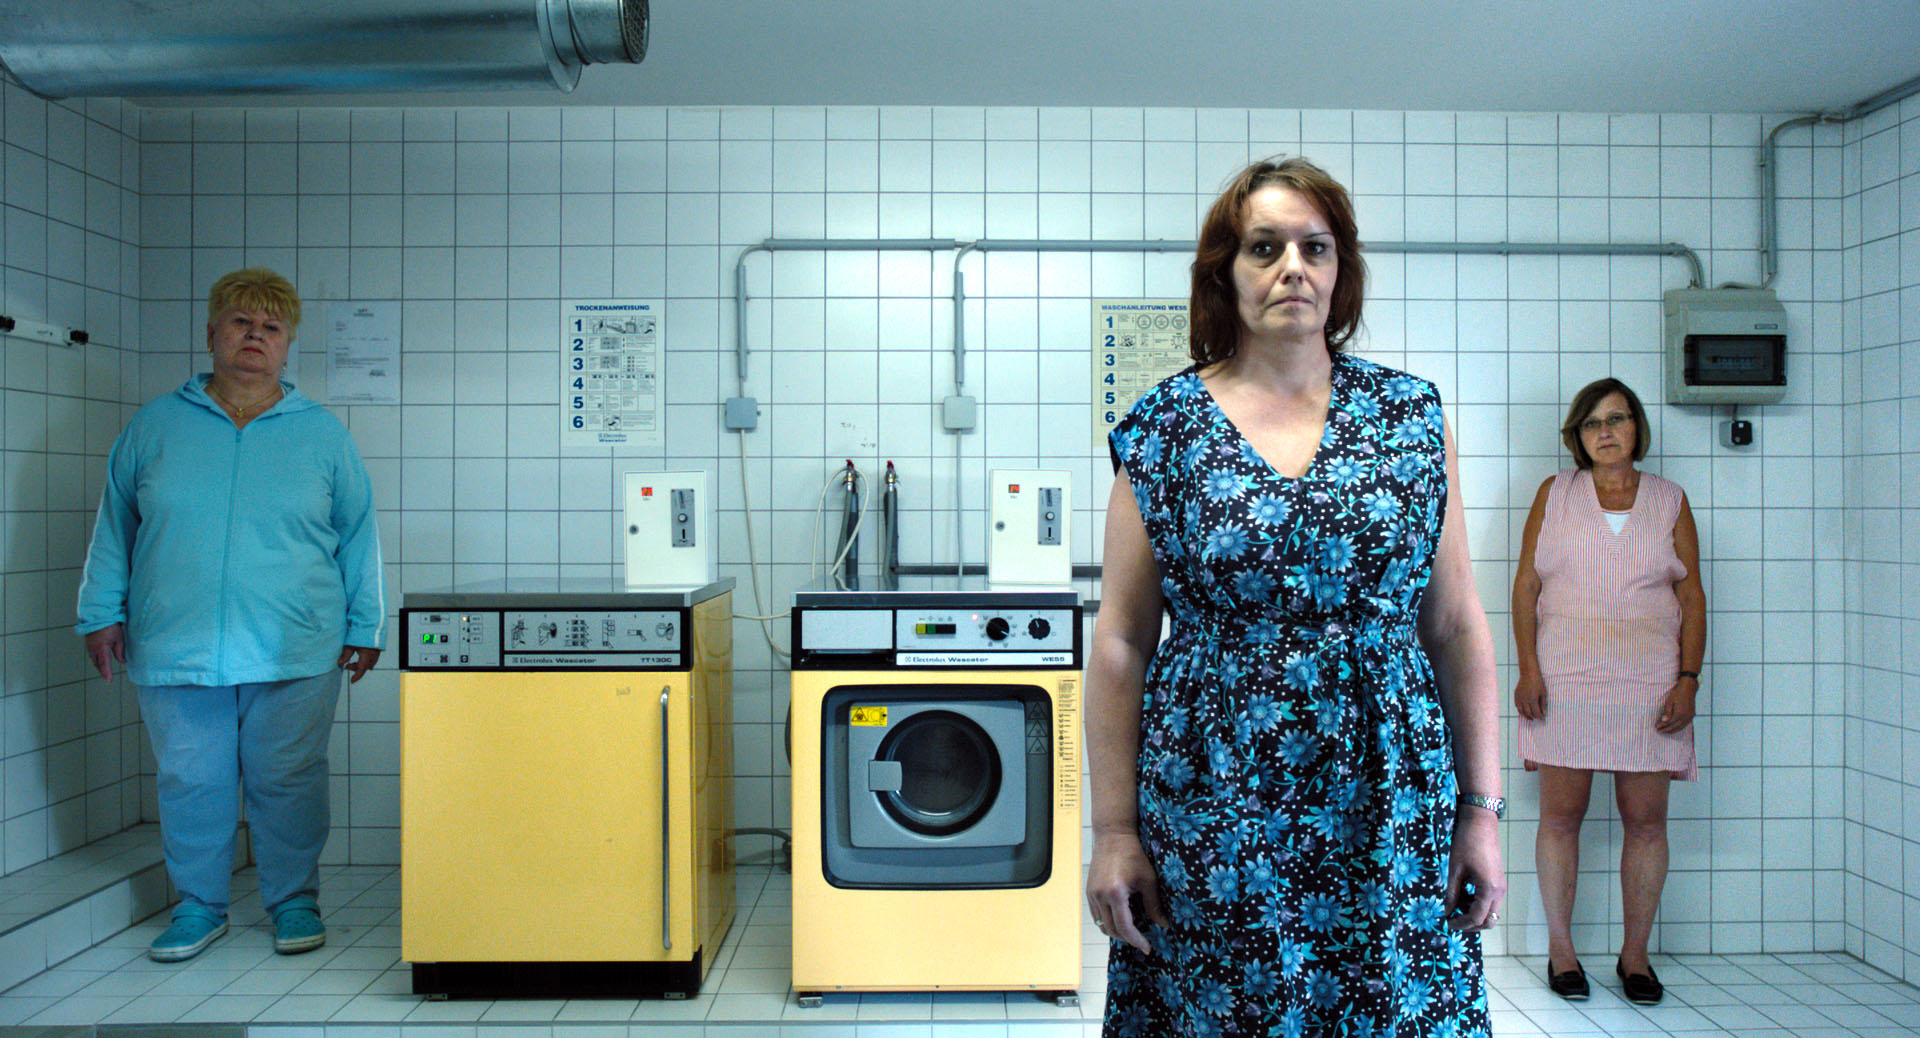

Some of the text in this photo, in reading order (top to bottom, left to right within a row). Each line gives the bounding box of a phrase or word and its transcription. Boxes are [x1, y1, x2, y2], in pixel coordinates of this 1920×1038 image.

[574, 319, 582, 332] 1
[1105, 316, 1113, 328] 1
[572, 338, 584, 351] 2
[1104, 335, 1115, 347] 2
[572, 357, 584, 370] 3
[1104, 354, 1115, 366] 3
[572, 377, 584, 390] 4
[1104, 373, 1115, 385] 4
[572, 396, 584, 409] 5
[1104, 392, 1115, 404] 5
[572, 415, 584, 429] 6
[1104, 411, 1115, 423] 6
